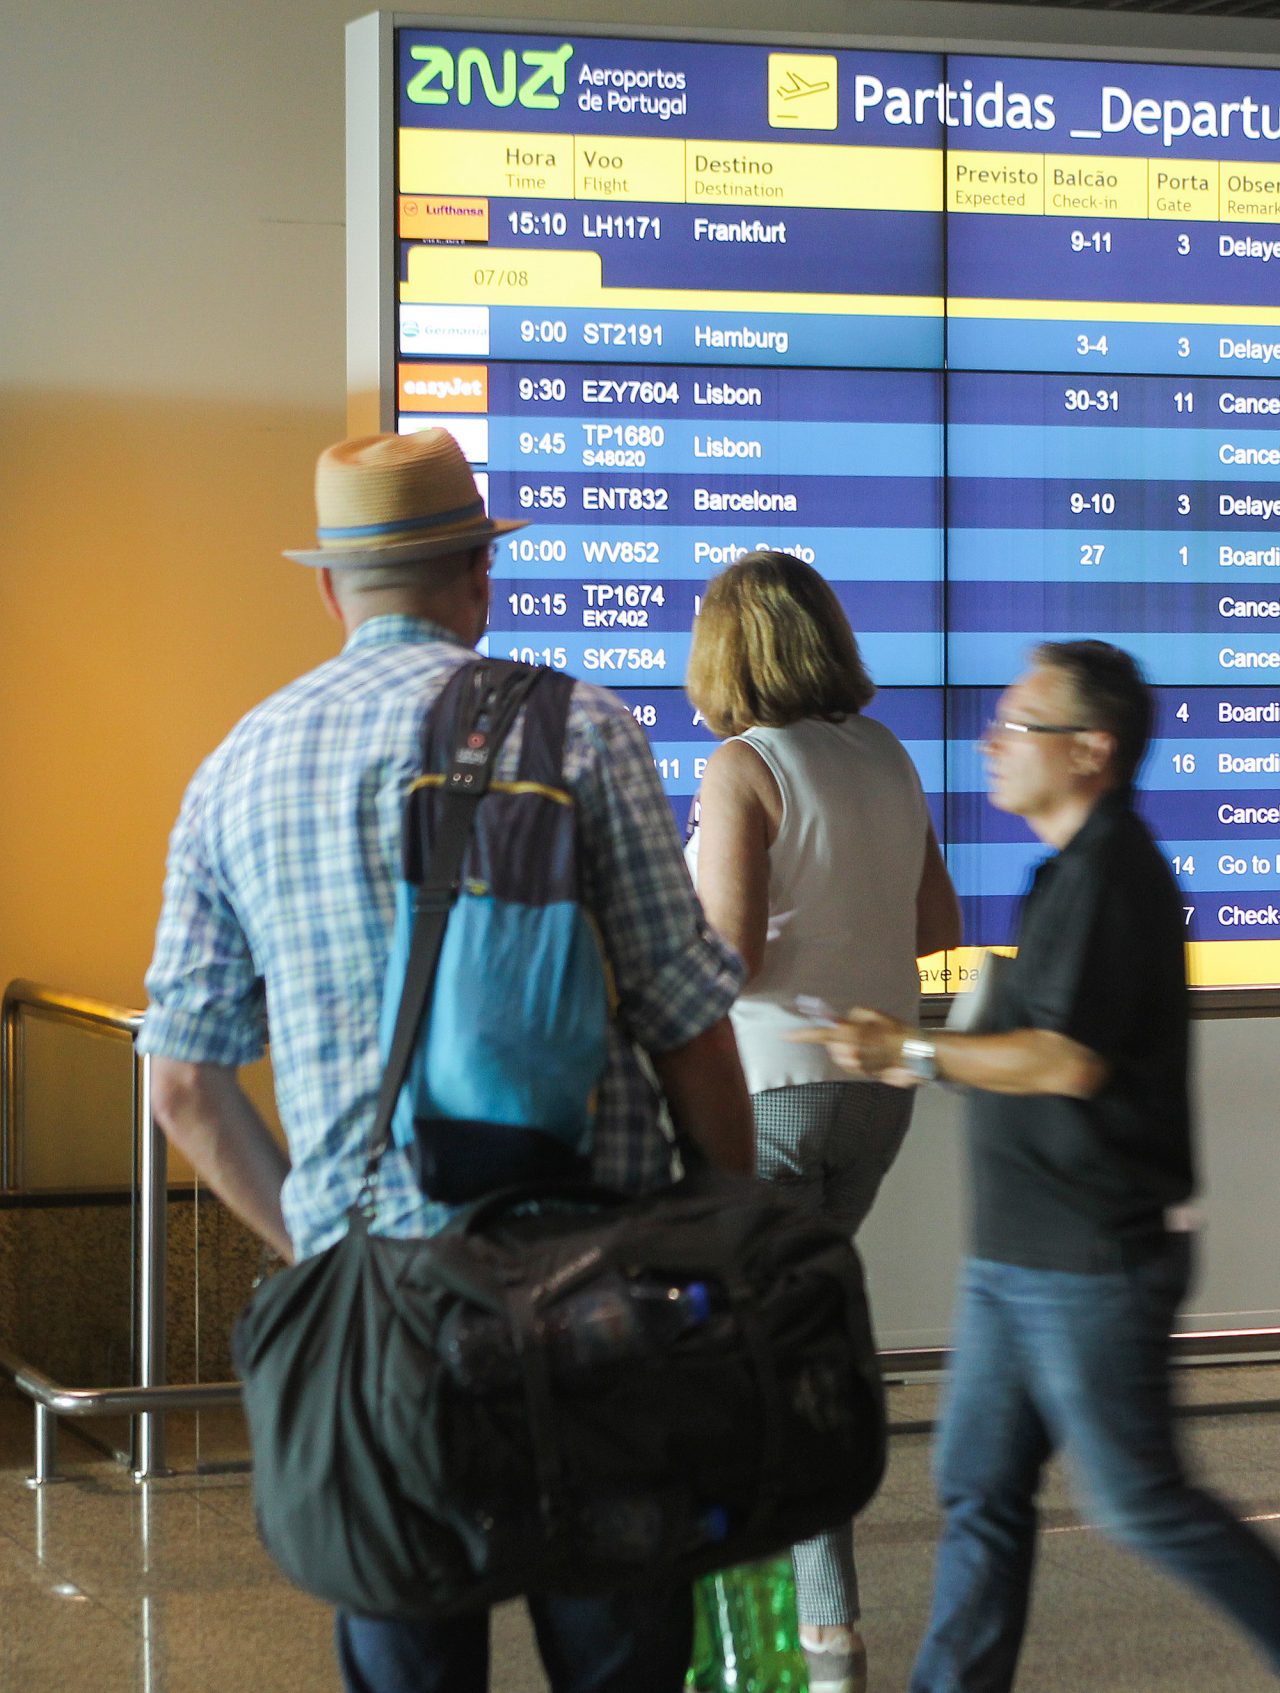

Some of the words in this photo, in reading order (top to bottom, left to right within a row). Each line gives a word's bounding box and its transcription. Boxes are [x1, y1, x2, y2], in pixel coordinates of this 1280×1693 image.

[578, 63, 686, 91] Aeroportos
[577, 90, 603, 112] de
[607, 92, 687, 120] Portugal
[855, 72, 1056, 132] Partidas
[506, 147, 556, 167] Hora
[583, 150, 623, 169] Voo
[695, 154, 773, 175] Destino
[956, 164, 1038, 185] Previsto
[1053, 168, 1118, 188] Balcão
[1157, 172, 1209, 191] Porta
[507, 173, 546, 189] Time
[583, 176, 628, 195] Flight
[694, 180, 784, 198] Destination
[954, 190, 1026, 210] Expected
[1052, 193, 1118, 209] Check-in
[1156, 197, 1192, 213] Gate
[425, 204, 485, 217] Lufthansa
[508, 211, 568, 237] 15:10
[582, 214, 660, 240] LH1171
[694, 218, 787, 244] Frankfurt
[1070, 230, 1111, 254] 9-11
[1177, 233, 1191, 256] 3
[474, 269, 529, 287] 07/08
[520, 320, 567, 344] 9:00
[583, 322, 664, 346] ST2191
[694, 325, 789, 353] Hamburg
[1076, 334, 1109, 356] 3-4
[1177, 337, 1190, 358] 3
[403, 377, 483, 399] easyJet
[518, 377, 566, 401] 9:30
[582, 379, 680, 404] EZY7604
[693, 382, 762, 406] Lisbon
[1064, 389, 1120, 412] 30-31
[1173, 391, 1193, 413] 11
[519, 432, 566, 455] 9:45
[582, 424, 665, 449] TP1680
[694, 435, 762, 458] Lisbon
[519, 485, 567, 510] 9:55
[582, 487, 669, 512] ENT832
[694, 488, 797, 513] Barcelona
[1070, 492, 1115, 514] 9-10
[1177, 494, 1191, 515] 3
[508, 539, 567, 562] 10:00
[582, 541, 660, 563] WV852
[1080, 544, 1105, 565] 27
[1178, 545, 1188, 566] 1
[508, 593, 567, 617] 10:15
[582, 584, 666, 609] TP1674
[581, 608, 649, 629] EK7402
[507, 647, 567, 671] 10:15
[583, 648, 666, 670] SK7584
[1175, 702, 1190, 724] 4
[1172, 753, 1196, 775] 16
[1171, 855, 1195, 877] 14
[1218, 855, 1248, 876] Go
[1251, 855, 1271, 876] to
[919, 966, 952, 983] ave
